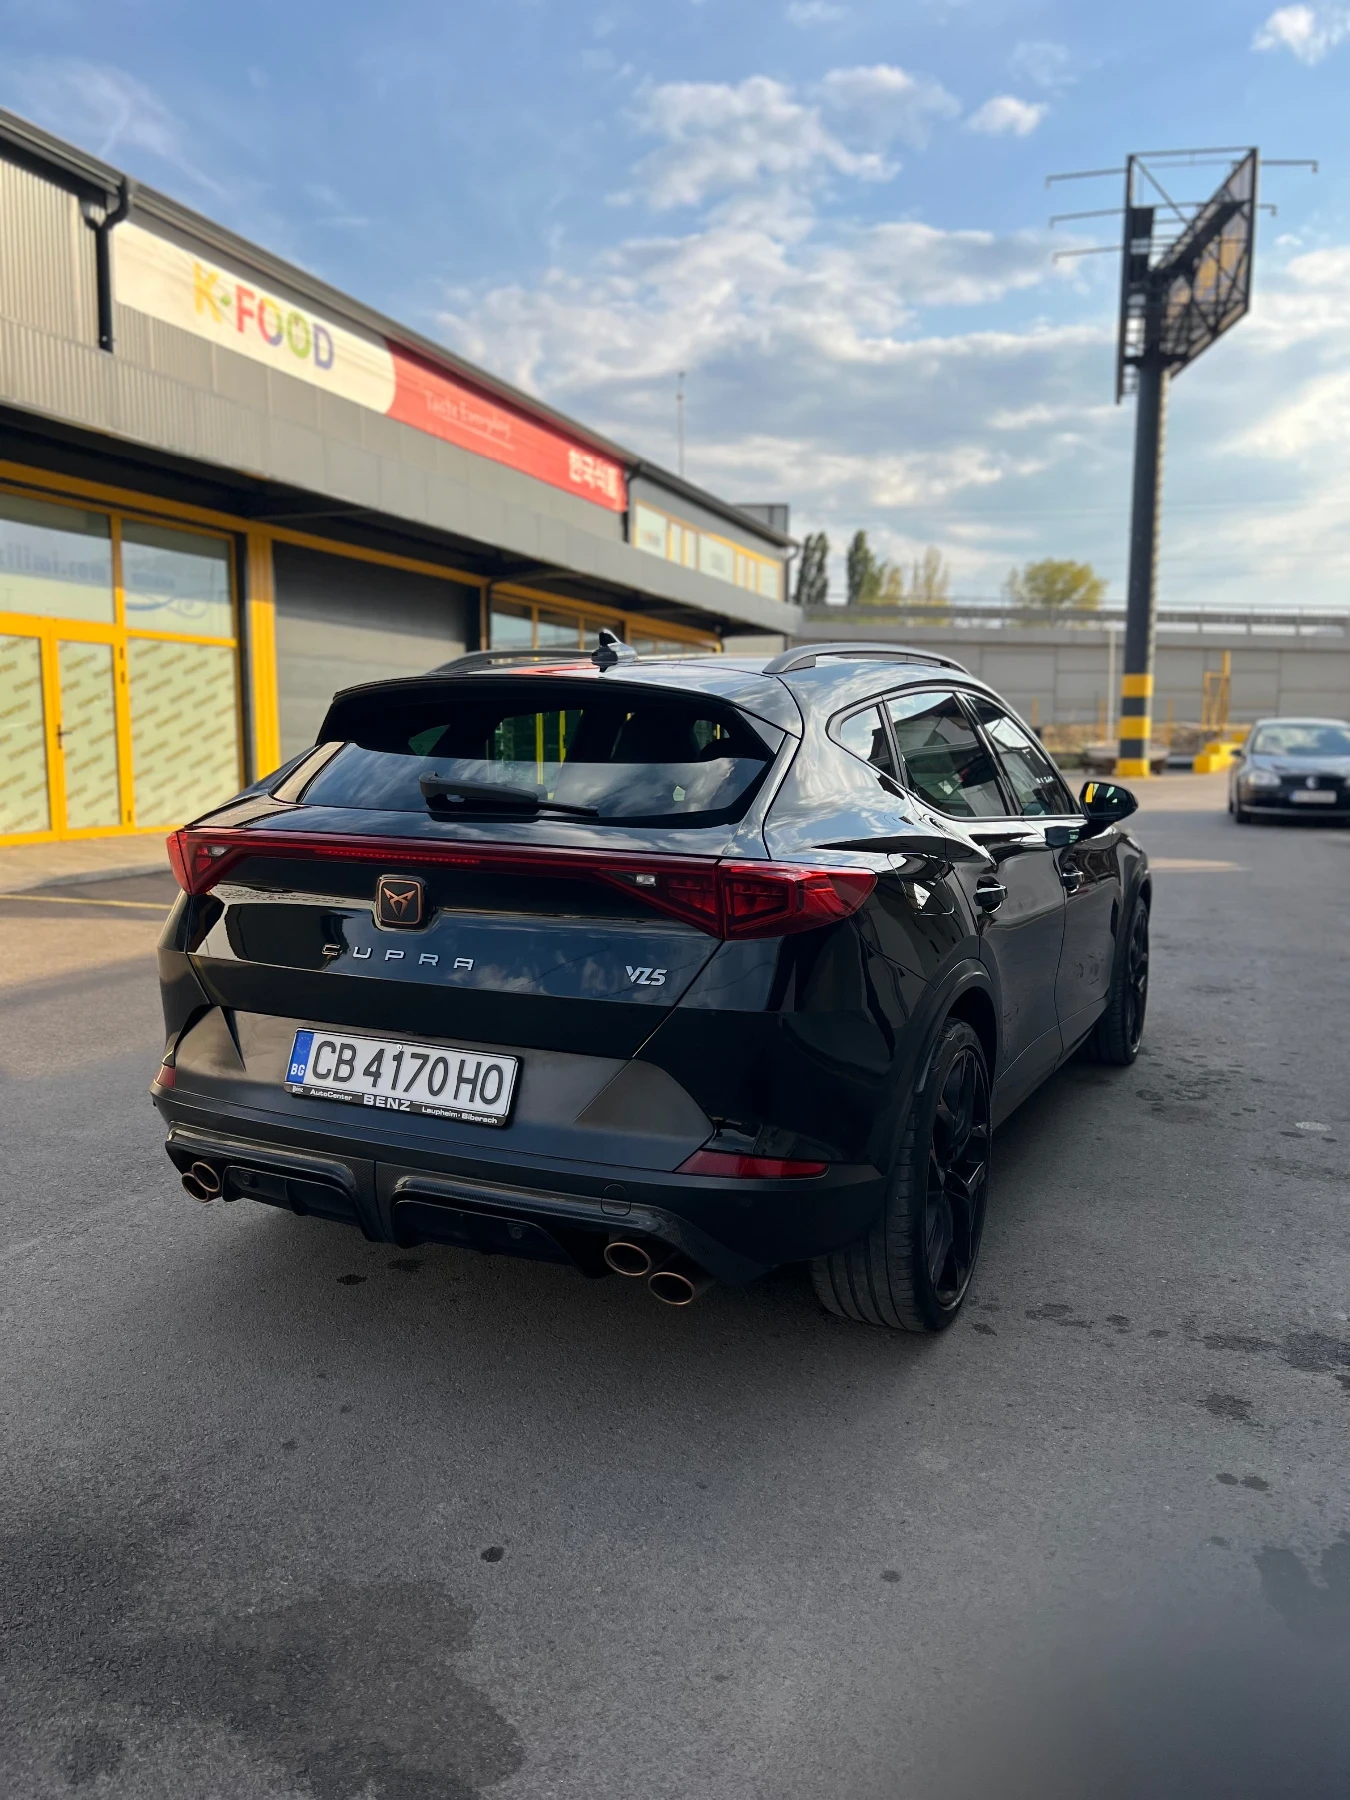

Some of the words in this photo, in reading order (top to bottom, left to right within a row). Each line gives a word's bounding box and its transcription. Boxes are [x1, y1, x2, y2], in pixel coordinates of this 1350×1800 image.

[321, 942, 475, 971] CUPRA
[625, 965, 668, 986] VZ5
[290, 1063, 305, 1076] BG
[312, 1040, 357, 1083] CB
[363, 1048, 448, 1096] 4170
[310, 1088, 353, 1101] AutoCenter
[363, 1094, 411, 1111] BENZ
